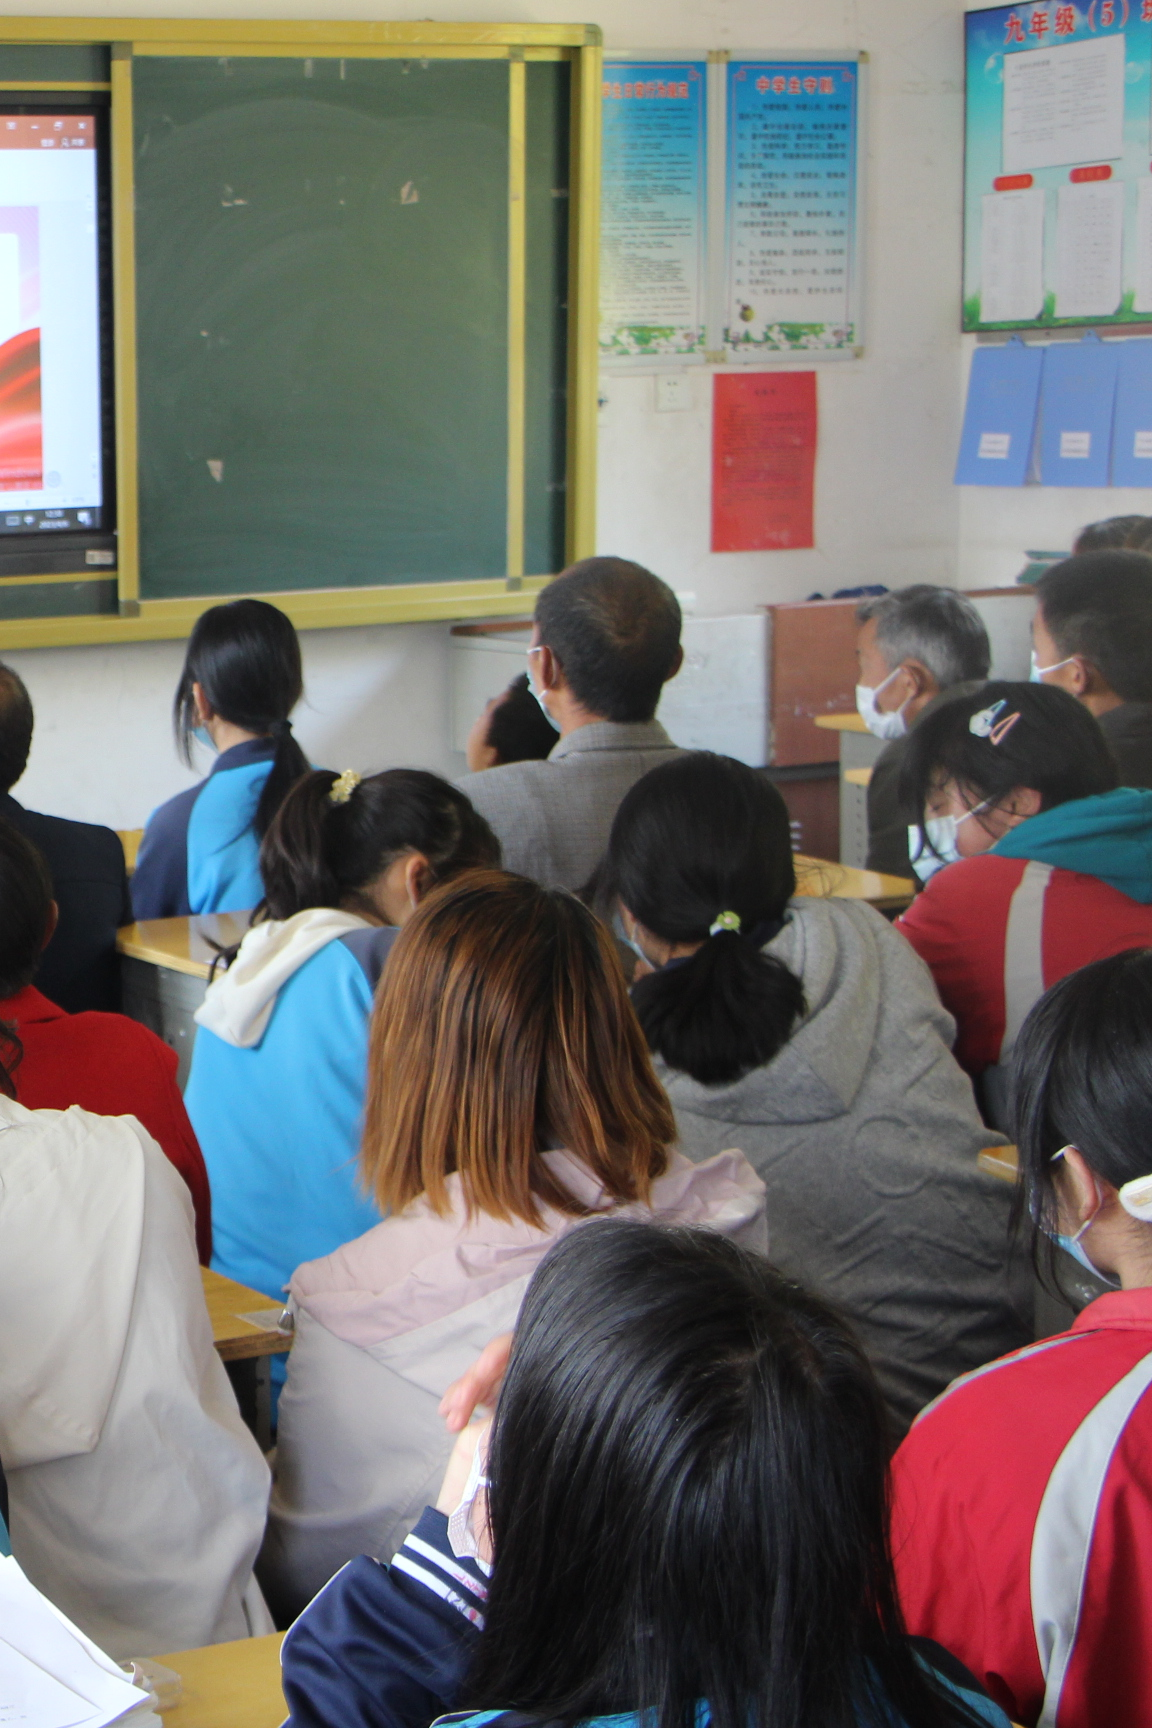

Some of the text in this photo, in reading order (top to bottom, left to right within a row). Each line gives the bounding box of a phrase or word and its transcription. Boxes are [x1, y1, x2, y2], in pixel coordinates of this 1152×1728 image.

[755, 75, 835, 95] 中学生守则
